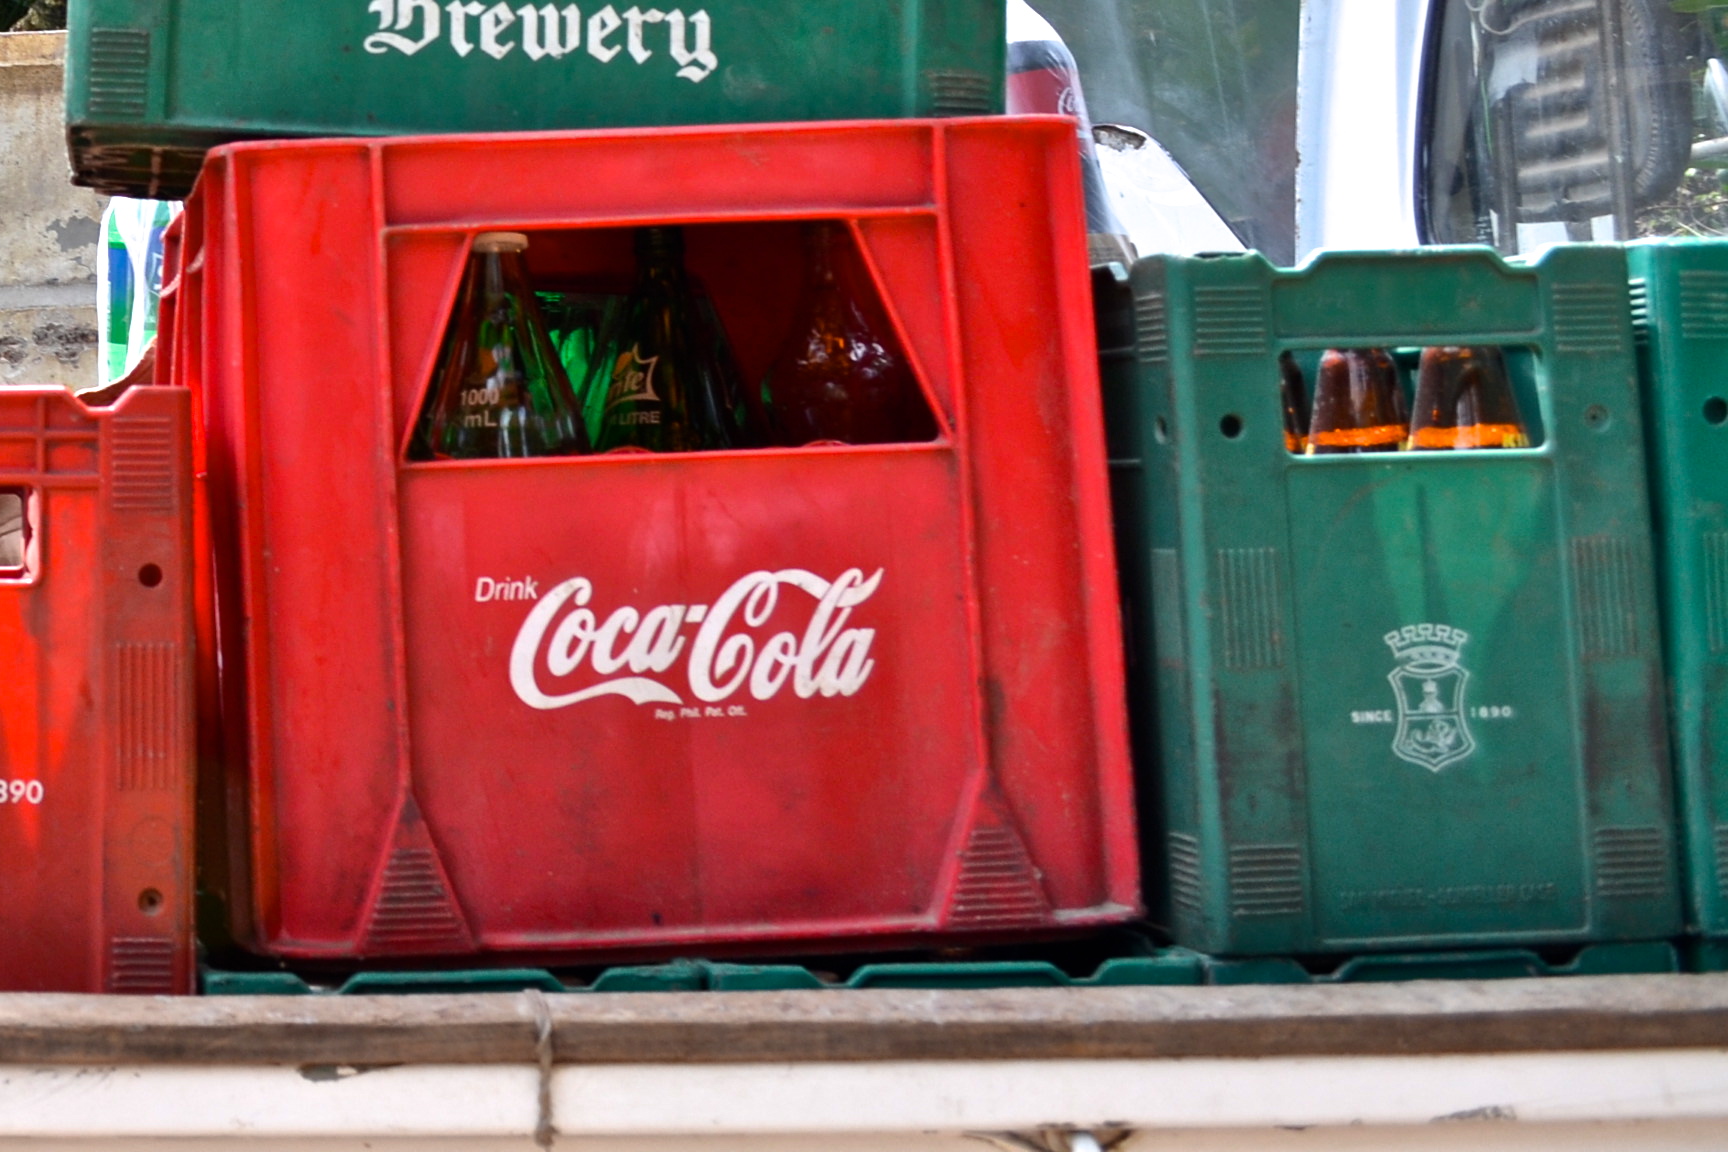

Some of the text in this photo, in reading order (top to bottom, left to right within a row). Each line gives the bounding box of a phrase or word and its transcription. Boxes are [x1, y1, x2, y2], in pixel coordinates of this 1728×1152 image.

[460, 389, 500, 406] 1000
[475, 567, 884, 710] Drink Coca-Cola
[1350, 705, 1514, 724] SINCE 1890
